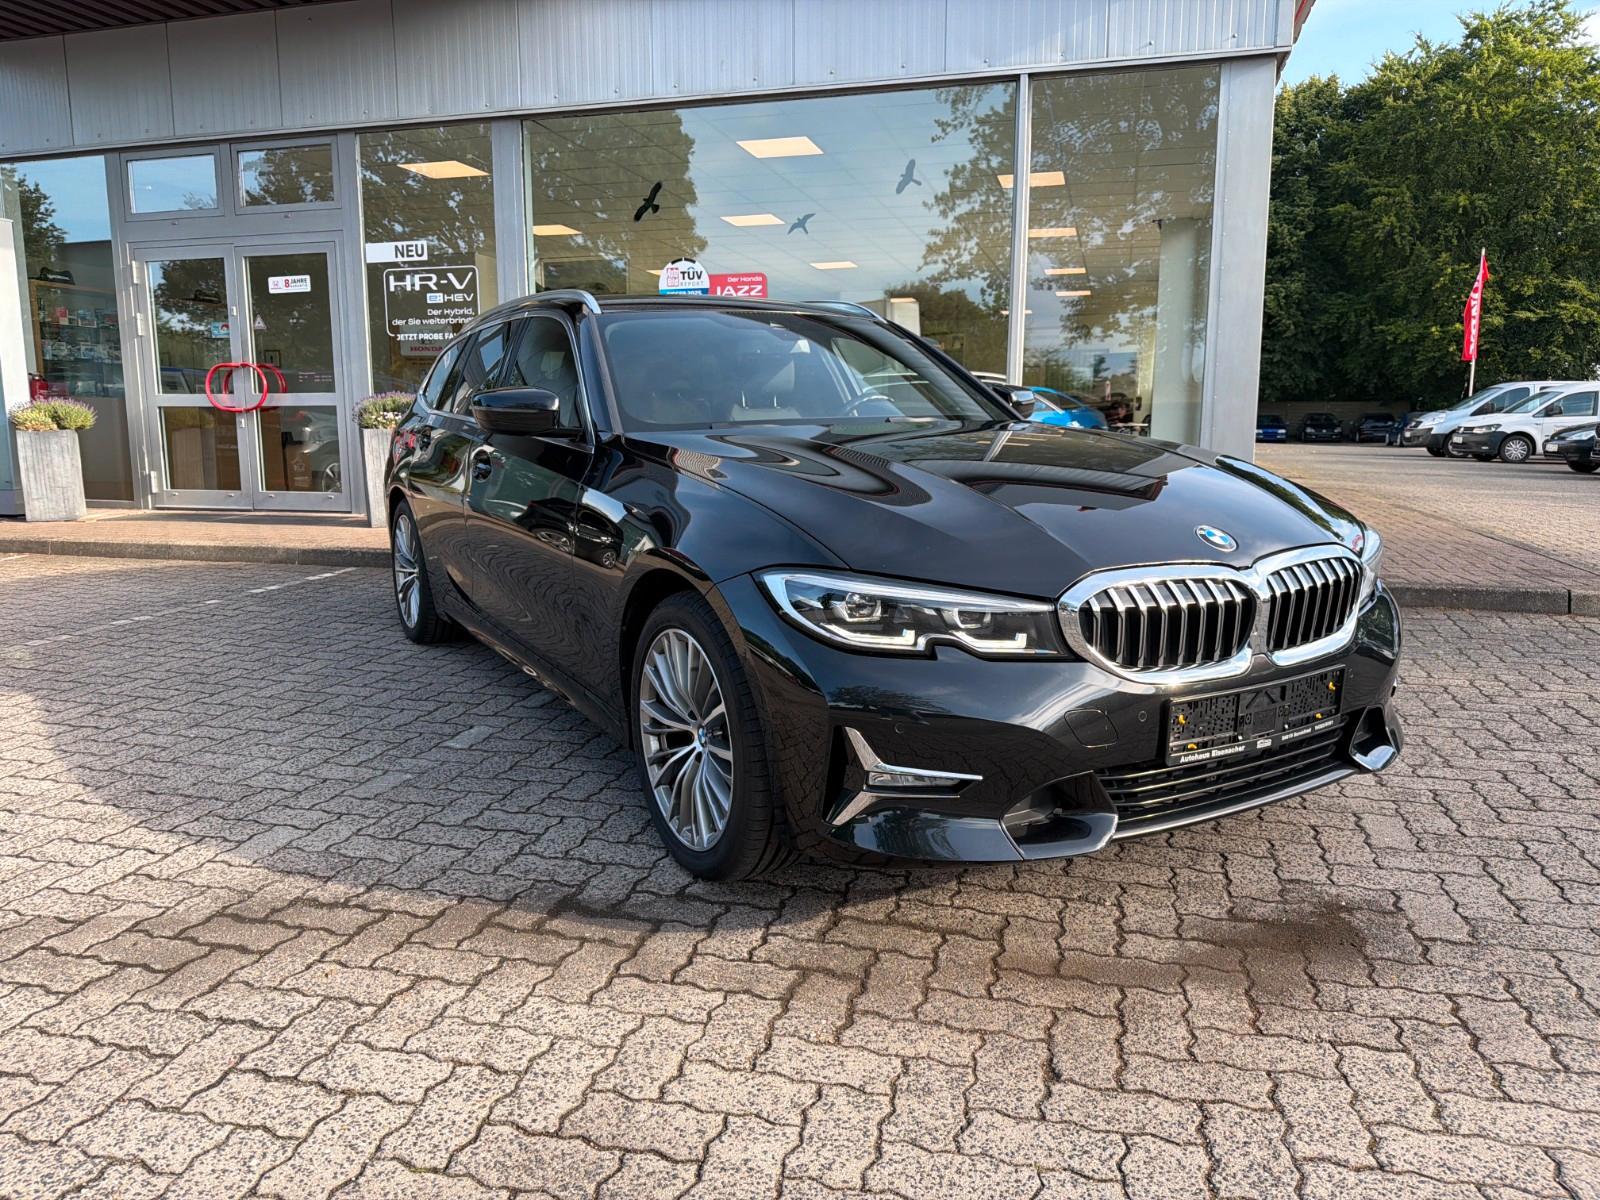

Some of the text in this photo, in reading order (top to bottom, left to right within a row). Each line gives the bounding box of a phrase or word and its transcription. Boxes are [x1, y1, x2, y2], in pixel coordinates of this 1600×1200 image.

[394, 244, 424, 258] NEU
[284, 279, 290, 288] 8
[389, 272, 473, 292] HR-V
[444, 307, 475, 317] Hybrid,
[408, 317, 420, 326] Sie
[397, 333, 417, 341] JETZT
[1180, 749, 1210, 763] Autohaus
